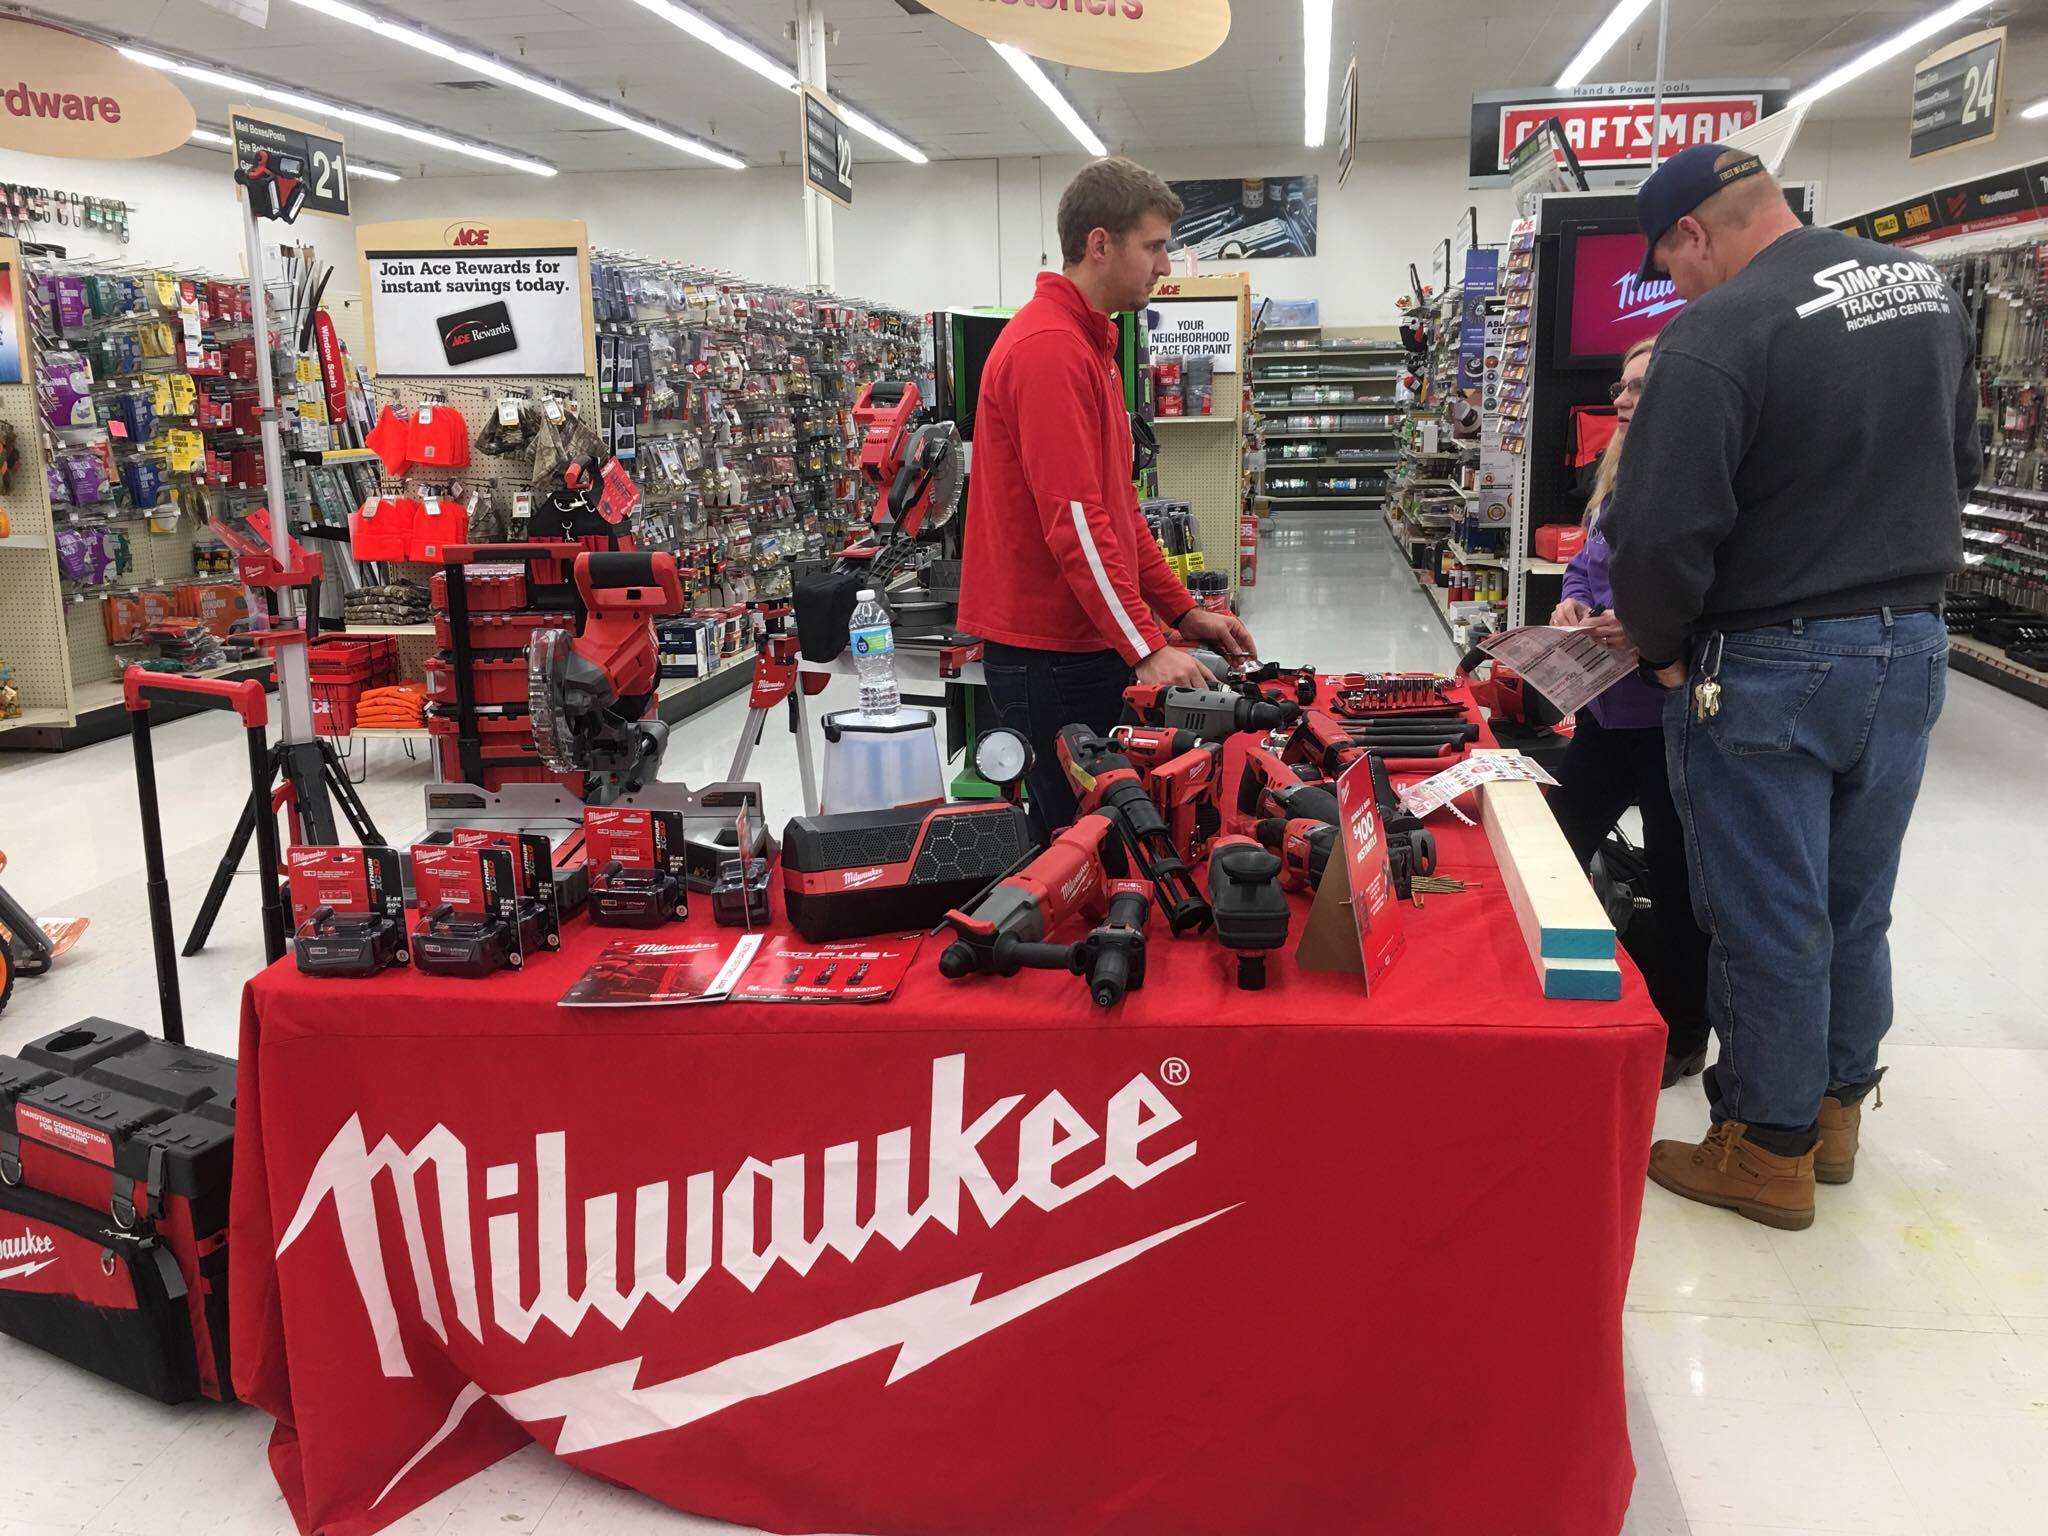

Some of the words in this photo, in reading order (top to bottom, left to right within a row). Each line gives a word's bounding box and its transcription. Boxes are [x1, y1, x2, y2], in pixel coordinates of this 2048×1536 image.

[1573, 86, 1603, 96] Hand
[1607, 85, 1615, 94] &
[1619, 84, 1655, 94] Power
[1660, 82, 1690, 93] ools
[1961, 58, 1995, 125] 24
[235, 120, 249, 132] Mail
[837, 133, 852, 190] 22
[313, 150, 345, 201] 21
[453, 227, 490, 246] ACE
[379, 261, 415, 276] Join
[420, 261, 450, 275] Ace
[456, 260, 531, 275] Rewards
[535, 259, 560, 273] for
[381, 279, 442, 293] instant
[446, 278, 511, 295] savings
[516, 278, 570, 294] today.
[1157, 284, 1181, 296] ACE
[1837, 284, 1920, 319] TRACTOR
[1920, 283, 1949, 301] INC.
[1177, 320, 1204, 331] YOUR
[1846, 308, 1898, 332] RICHLAND
[1899, 301, 1942, 317] CENTER,
[451, 333, 472, 347] ACE
[471, 322, 511, 342] Rewards
[1151, 332, 1230, 344] NEIGHBORHOOD
[320, 325, 332, 362] Window
[328, 362, 337, 389] Seals
[1149, 345, 1181, 356] PLACE
[1182, 345, 1201, 355] FOR
[1202, 344, 1232, 355] PAINT
[312, 698, 333, 714] CE
[587, 811, 620, 823] Milwaukee
[1352, 811, 1374, 845] $100
[457, 833, 488, 844] Milwaukee
[291, 850, 328, 864] Milwaukee
[414, 849, 448, 861] Milwaukee
[841, 867, 884, 886] Milwaukee
[1061, 860, 1091, 900] Milwaukee
[632, 942, 720, 955] Milwaukee
[812, 951, 900, 959] FUEL
[20, 1108, 53, 1126] HARDTOP
[53, 1119, 107, 1145] CONSTRUCTION
[39, 1122, 53, 1133] FOR
[53, 1125, 89, 1145] STACKING
[275, 1053, 1199, 1377] Milwaukee
[0, 1227, 56, 1261] aukee
